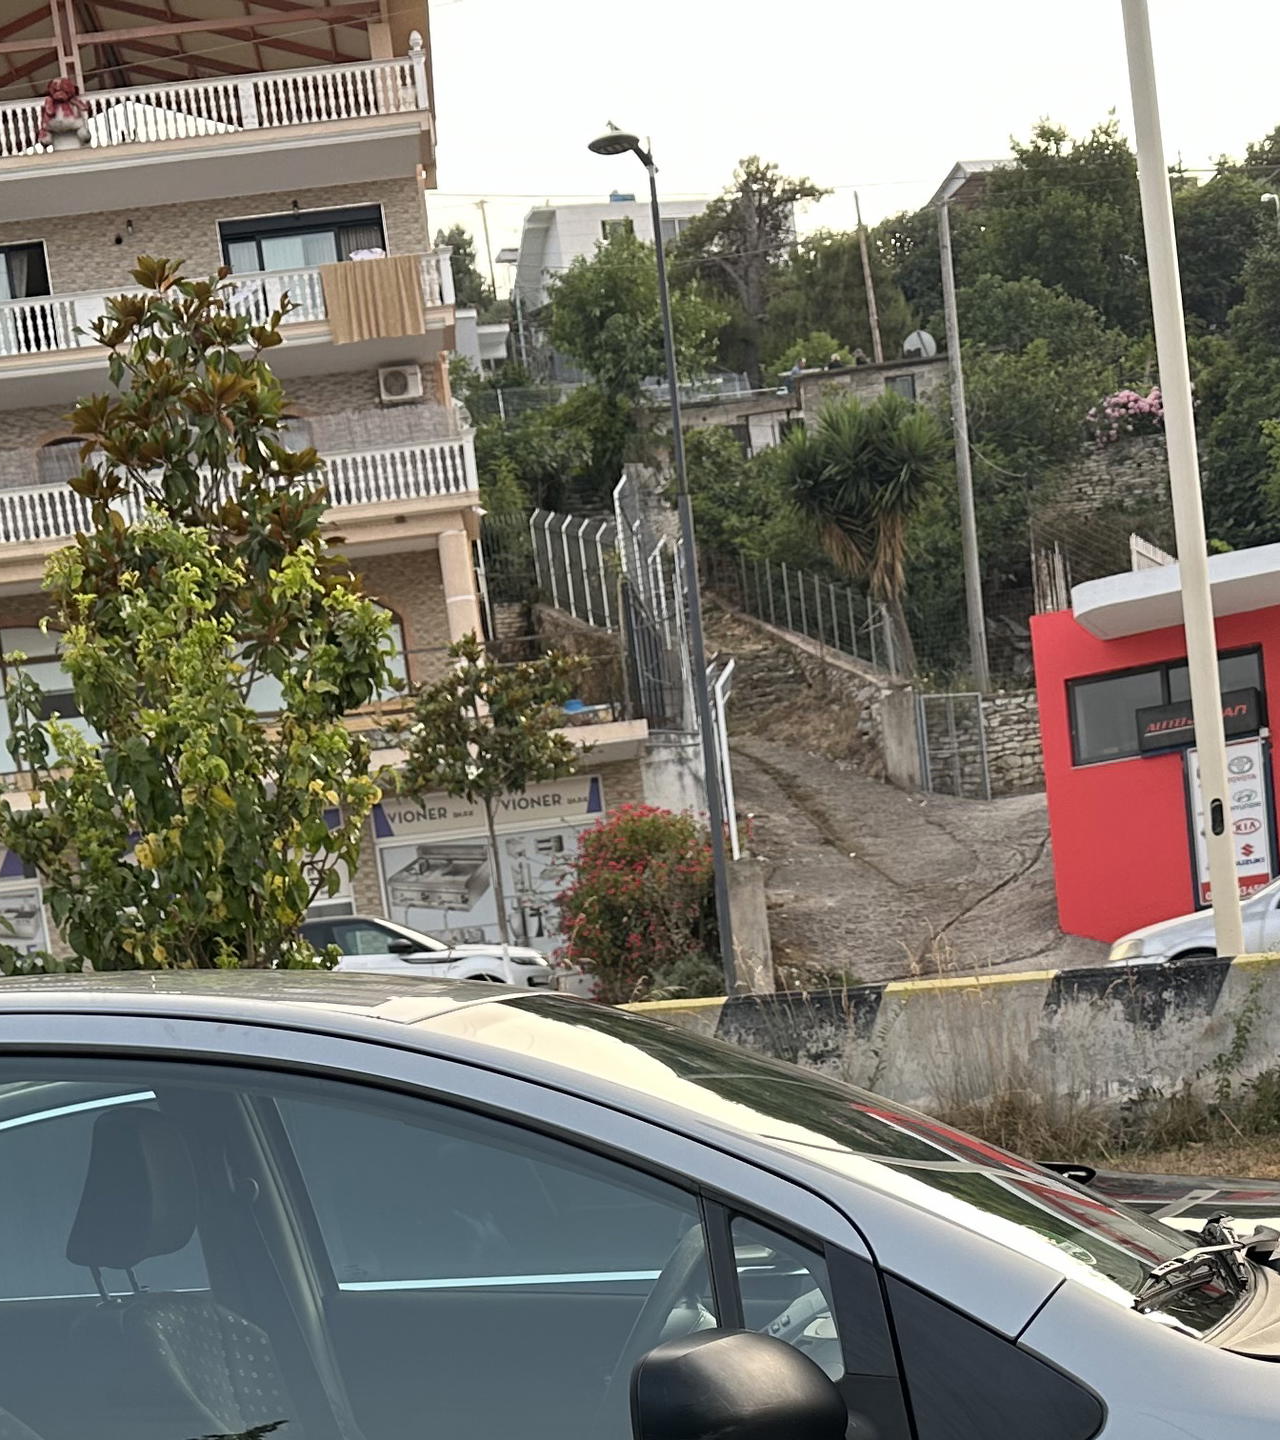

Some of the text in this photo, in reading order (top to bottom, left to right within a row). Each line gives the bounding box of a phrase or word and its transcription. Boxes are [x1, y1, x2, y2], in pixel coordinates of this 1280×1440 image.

[501, 794, 561, 810] VIONER
[388, 807, 447, 823] VIONER
[1234, 821, 1257, 833] KIA
